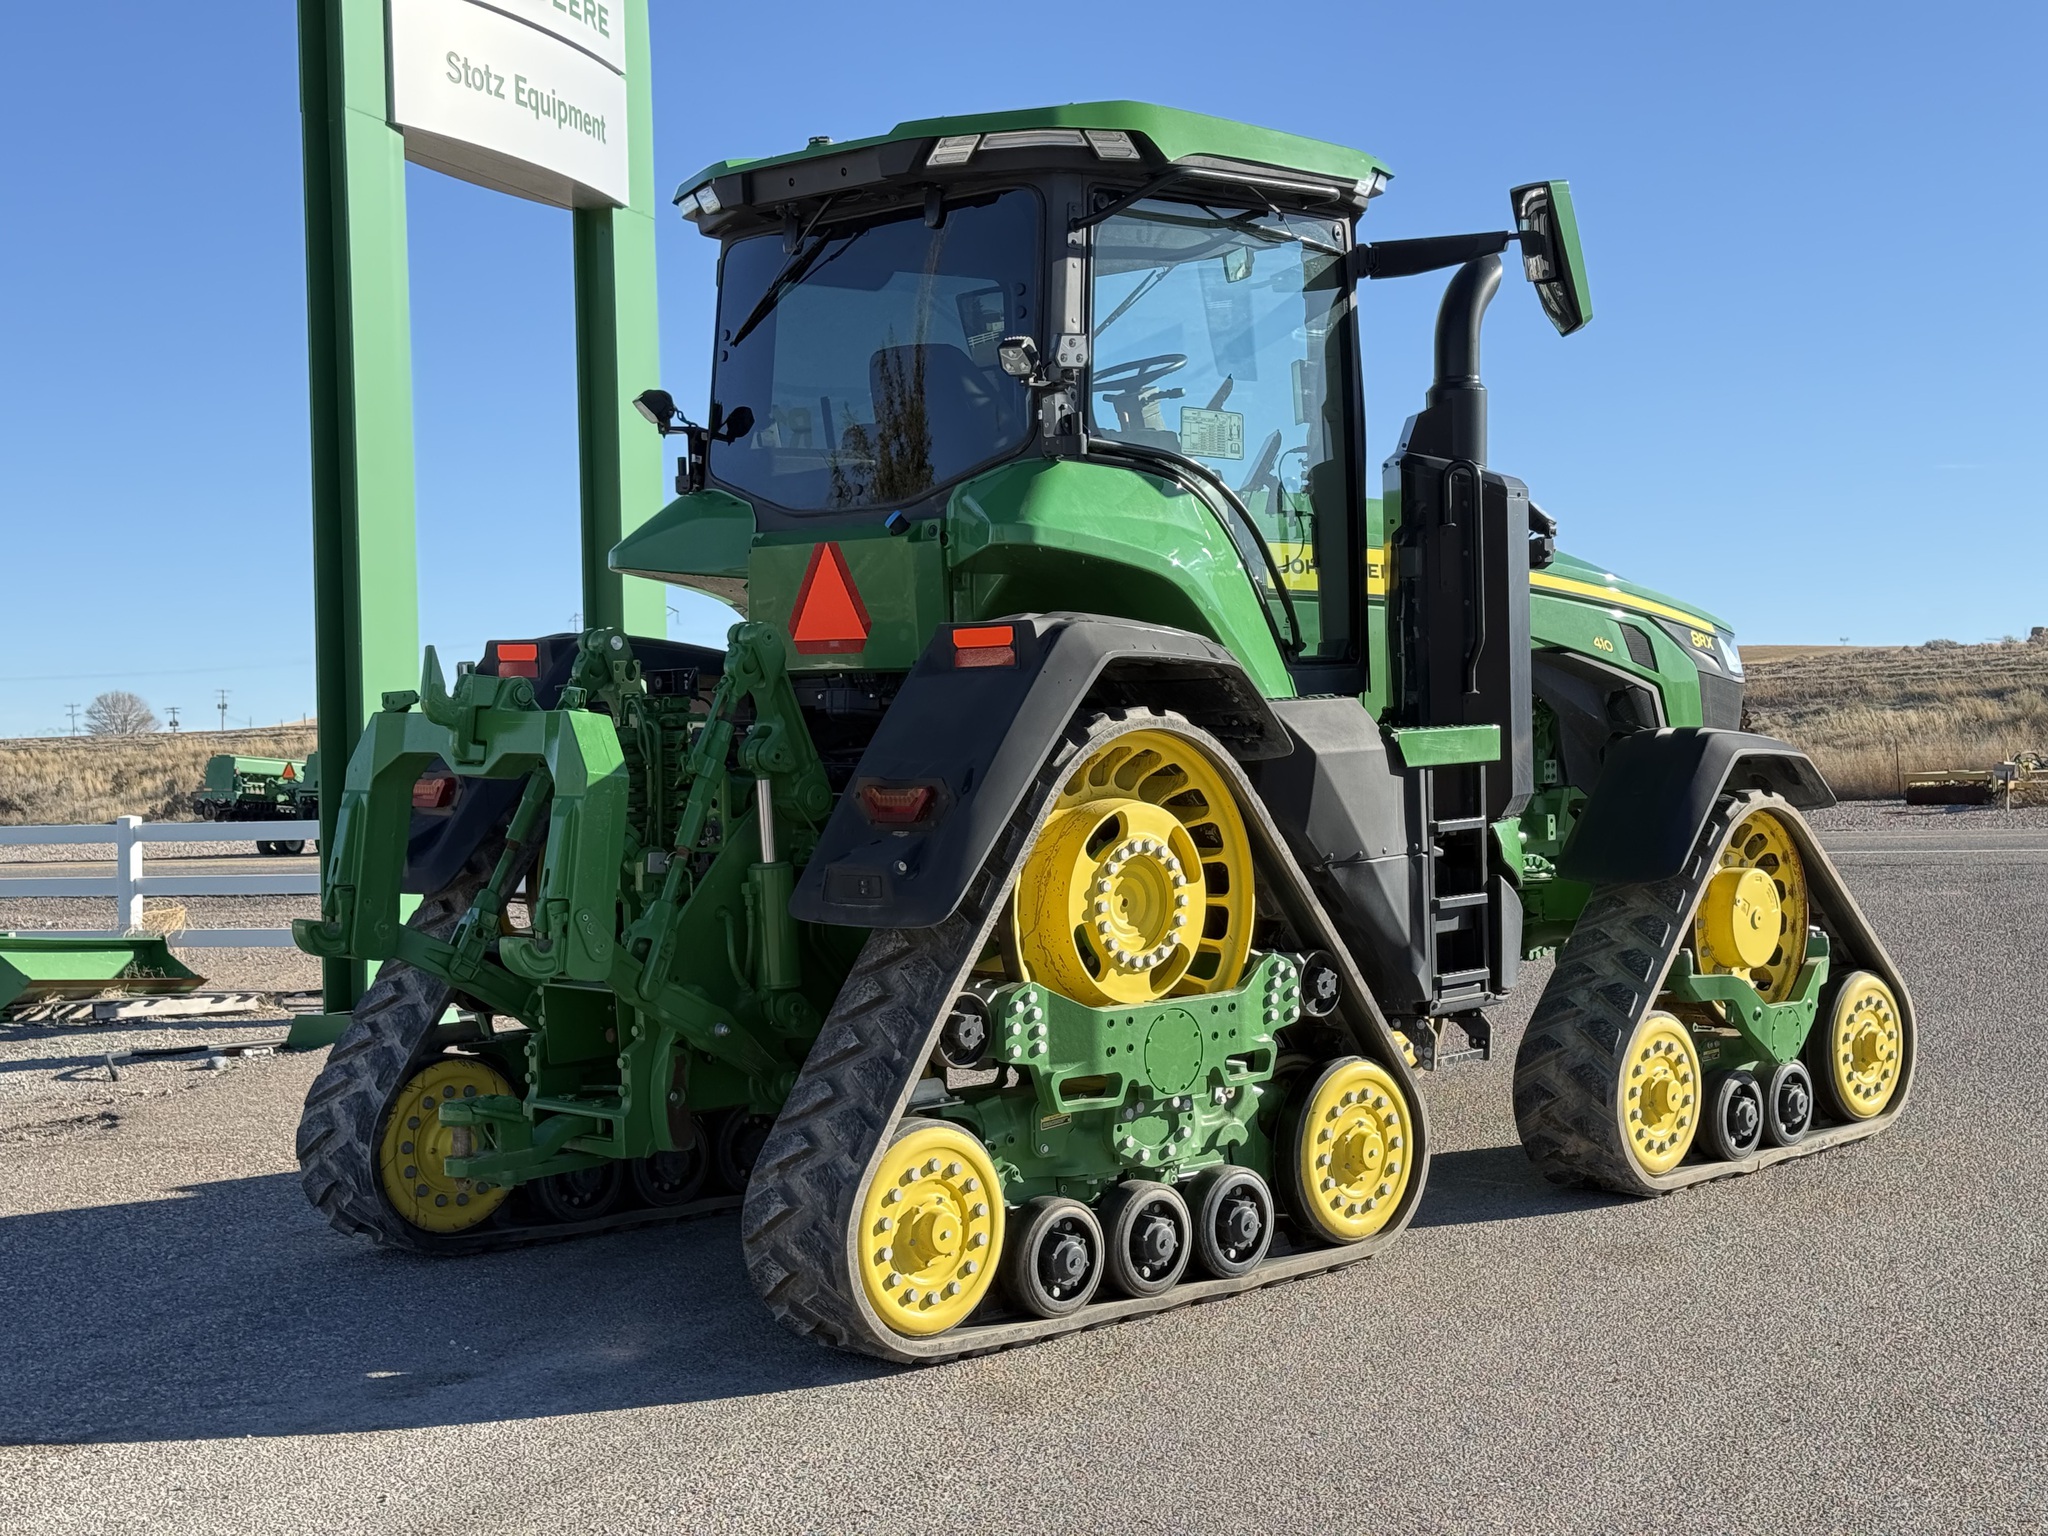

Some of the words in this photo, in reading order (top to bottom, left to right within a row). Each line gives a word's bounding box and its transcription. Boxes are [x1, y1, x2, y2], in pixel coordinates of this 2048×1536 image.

[445, 51, 505, 100] Stotz
[514, 73, 606, 144] Equipment
[1278, 554, 1319, 576] JOH
[1593, 636, 1614, 653] 410
[1690, 629, 1715, 651] 8RX
